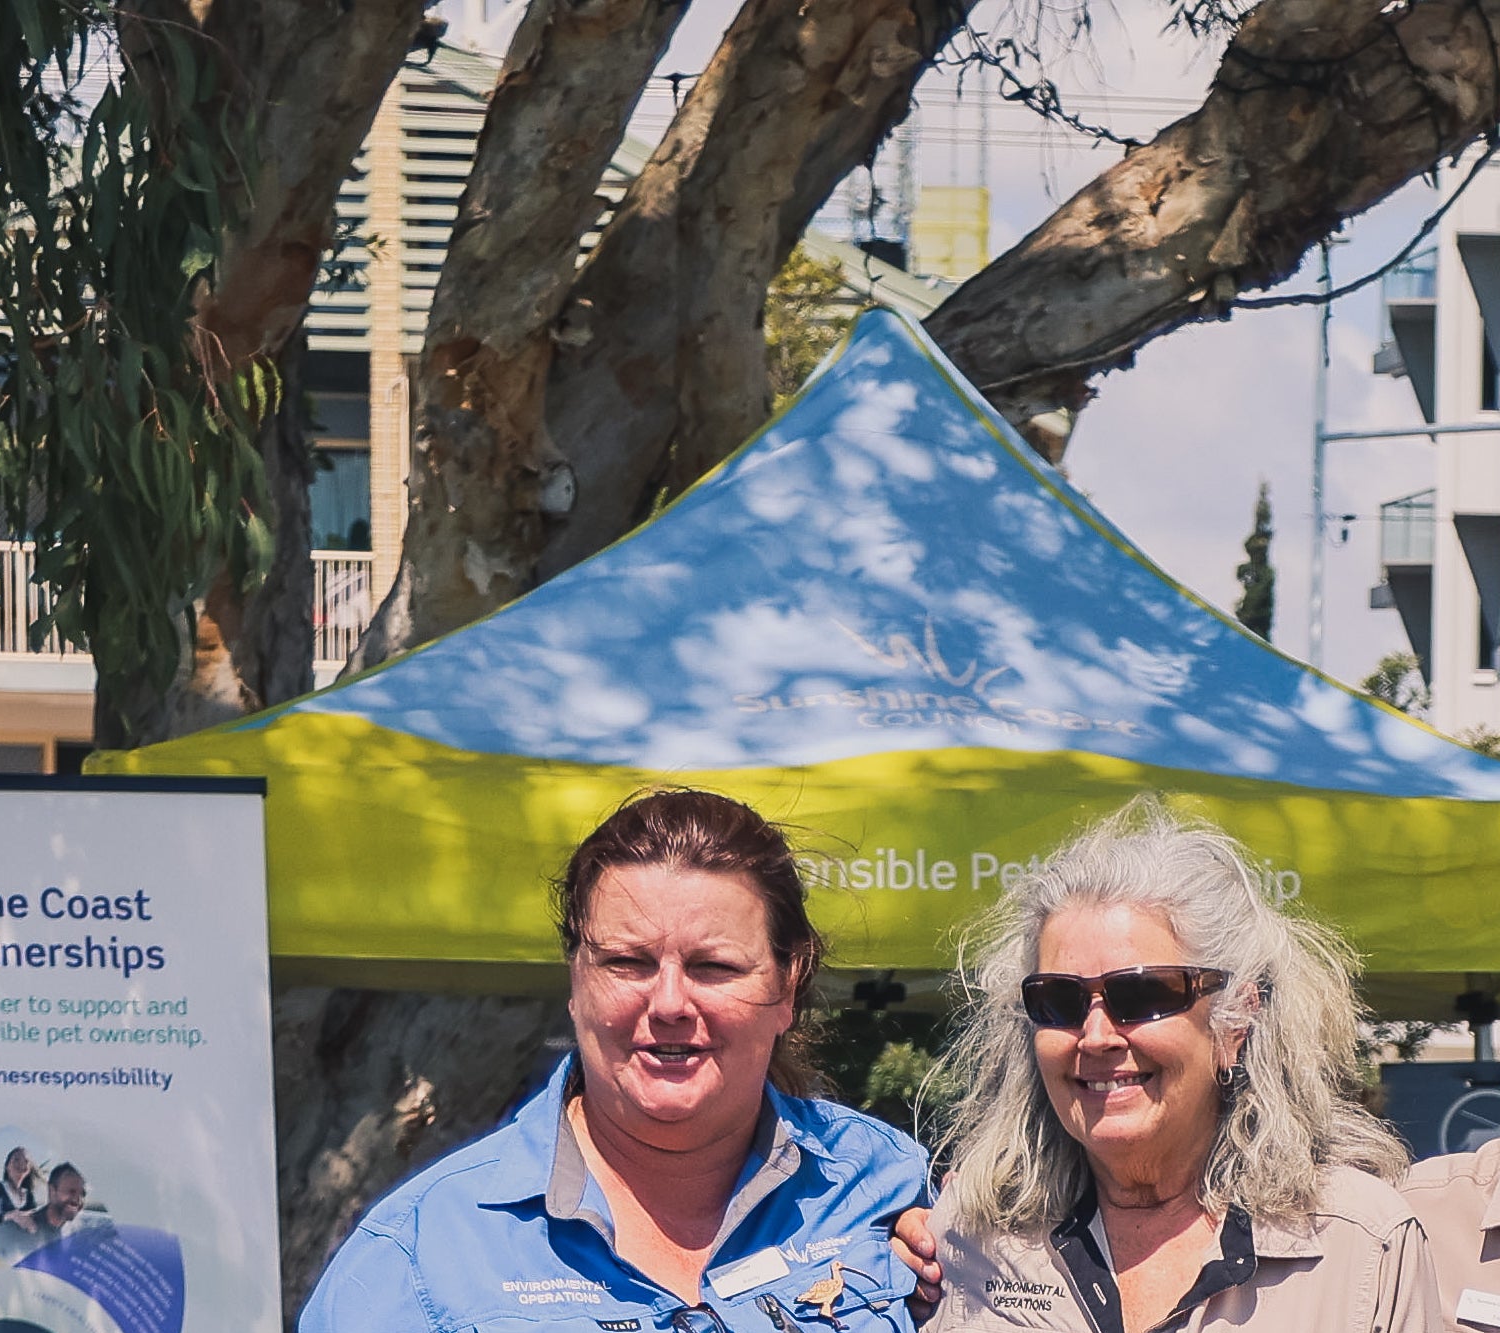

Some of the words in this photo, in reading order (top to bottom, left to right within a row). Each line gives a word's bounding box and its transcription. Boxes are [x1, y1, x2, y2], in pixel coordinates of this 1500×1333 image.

[797, 848, 957, 891] onsible
[40, 886, 153, 921] Coast
[28, 995, 52, 1014] to
[58, 995, 142, 1019] support
[146, 996, 189, 1016] and
[46, 1024, 84, 1048] pet
[88, 1024, 209, 1049] ownership.
[502, 1278, 612, 1292] ENVIRONMENTAL
[985, 1280, 1067, 1298] ENVIRONMENTAL
[519, 1291, 602, 1305] OPERATIONS
[993, 1296, 1052, 1312] OPERATIONS
